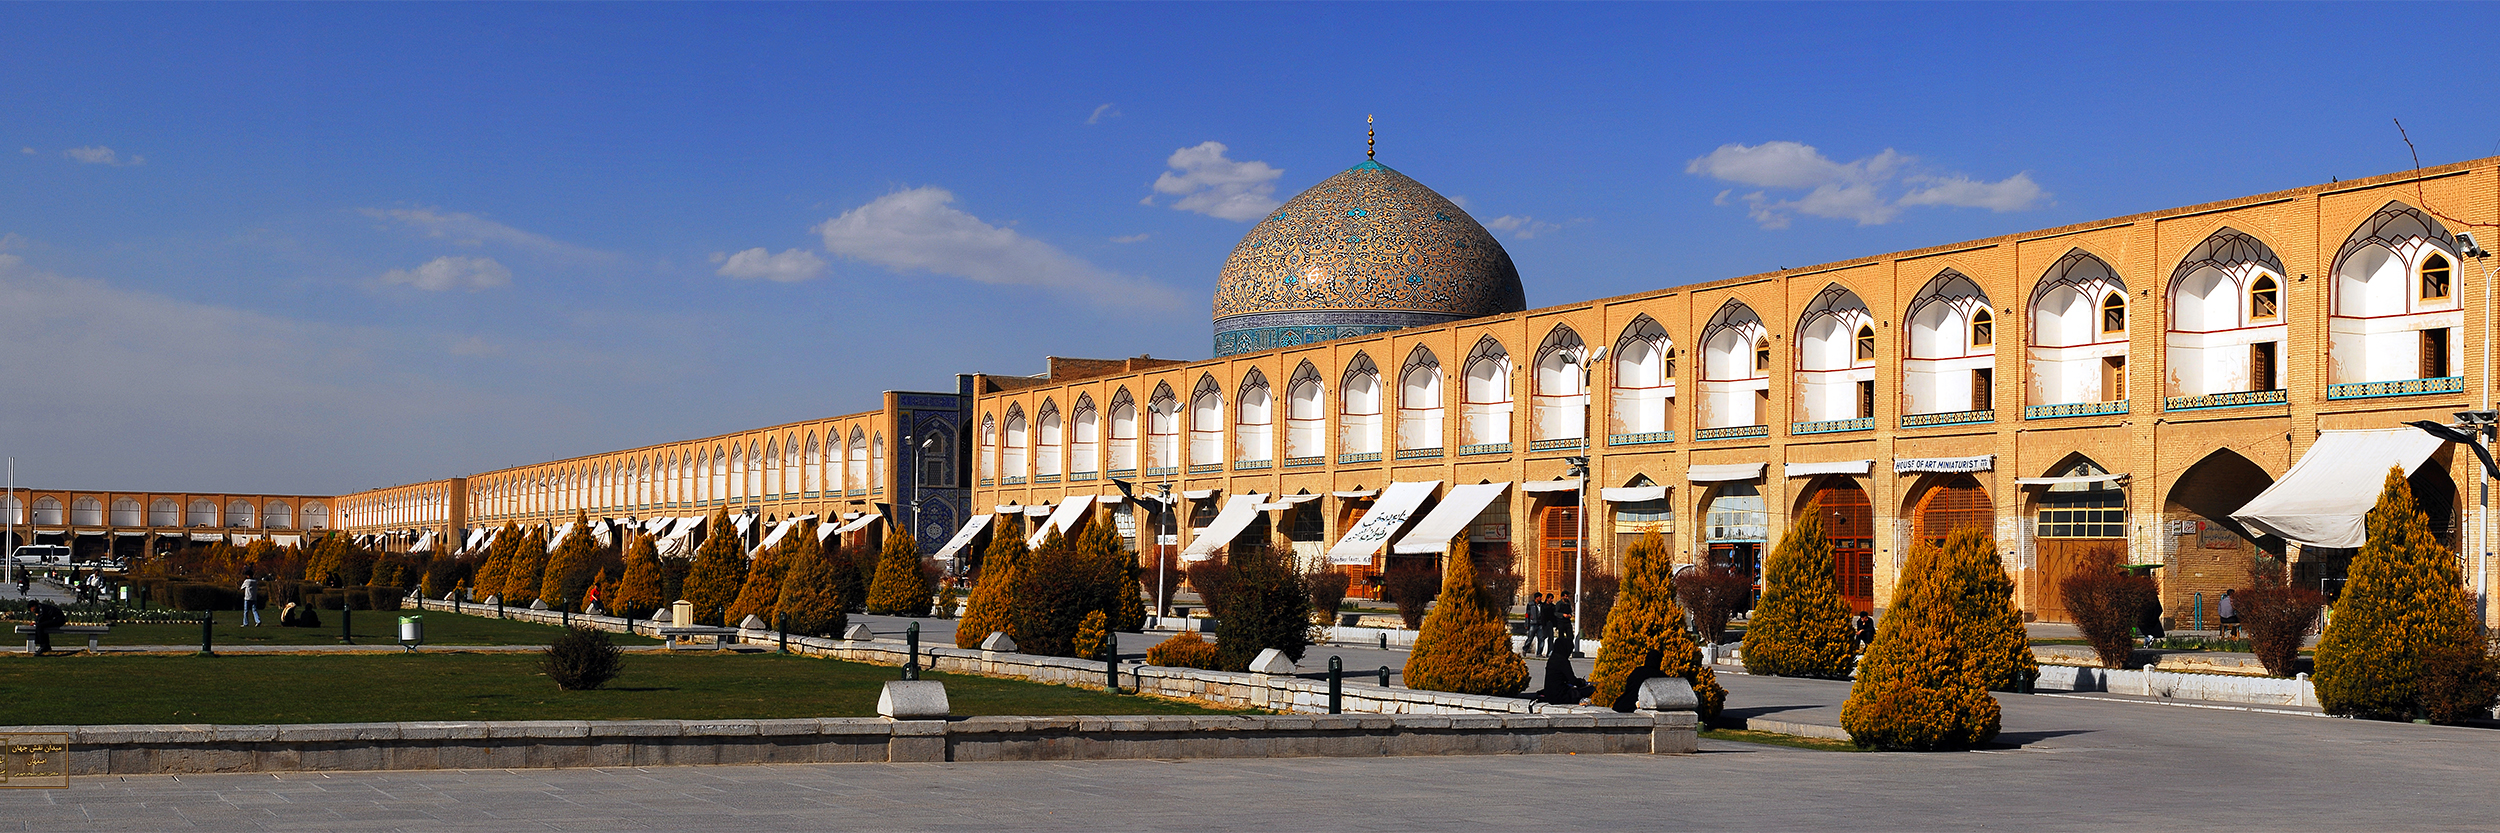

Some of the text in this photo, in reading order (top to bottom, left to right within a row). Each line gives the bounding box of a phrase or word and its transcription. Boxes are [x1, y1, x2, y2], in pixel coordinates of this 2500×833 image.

[1895, 460, 1978, 469] HOUSE OF ART MINIATURIST
